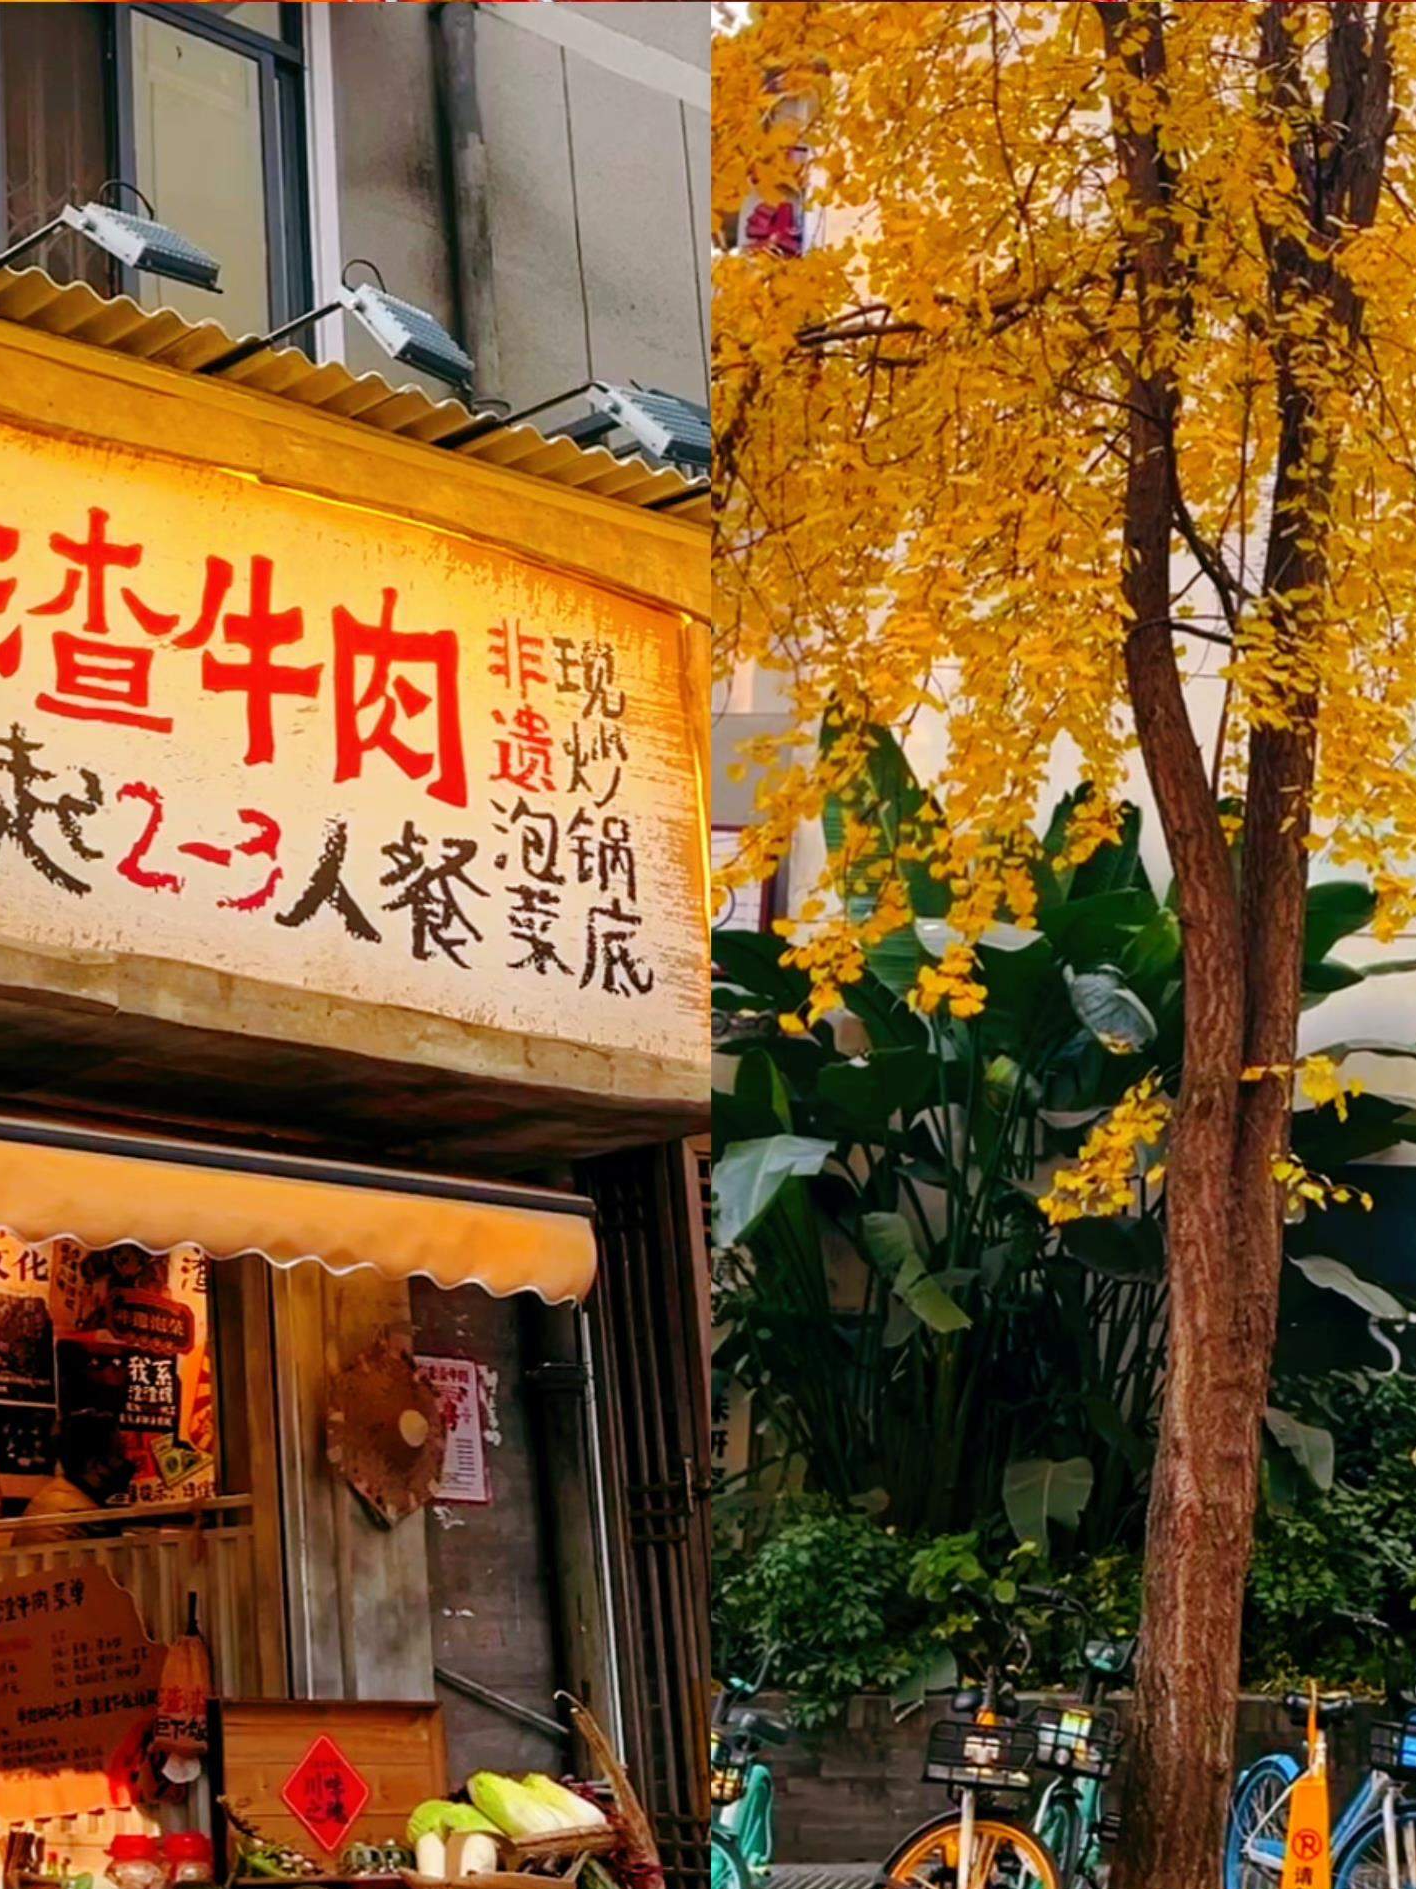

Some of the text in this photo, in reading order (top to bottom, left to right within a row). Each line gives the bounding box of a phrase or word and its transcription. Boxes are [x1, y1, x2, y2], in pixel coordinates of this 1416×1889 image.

[489, 616, 575, 976] 非遗泡菜
[551, 632, 654, 998] 现炒锅底
